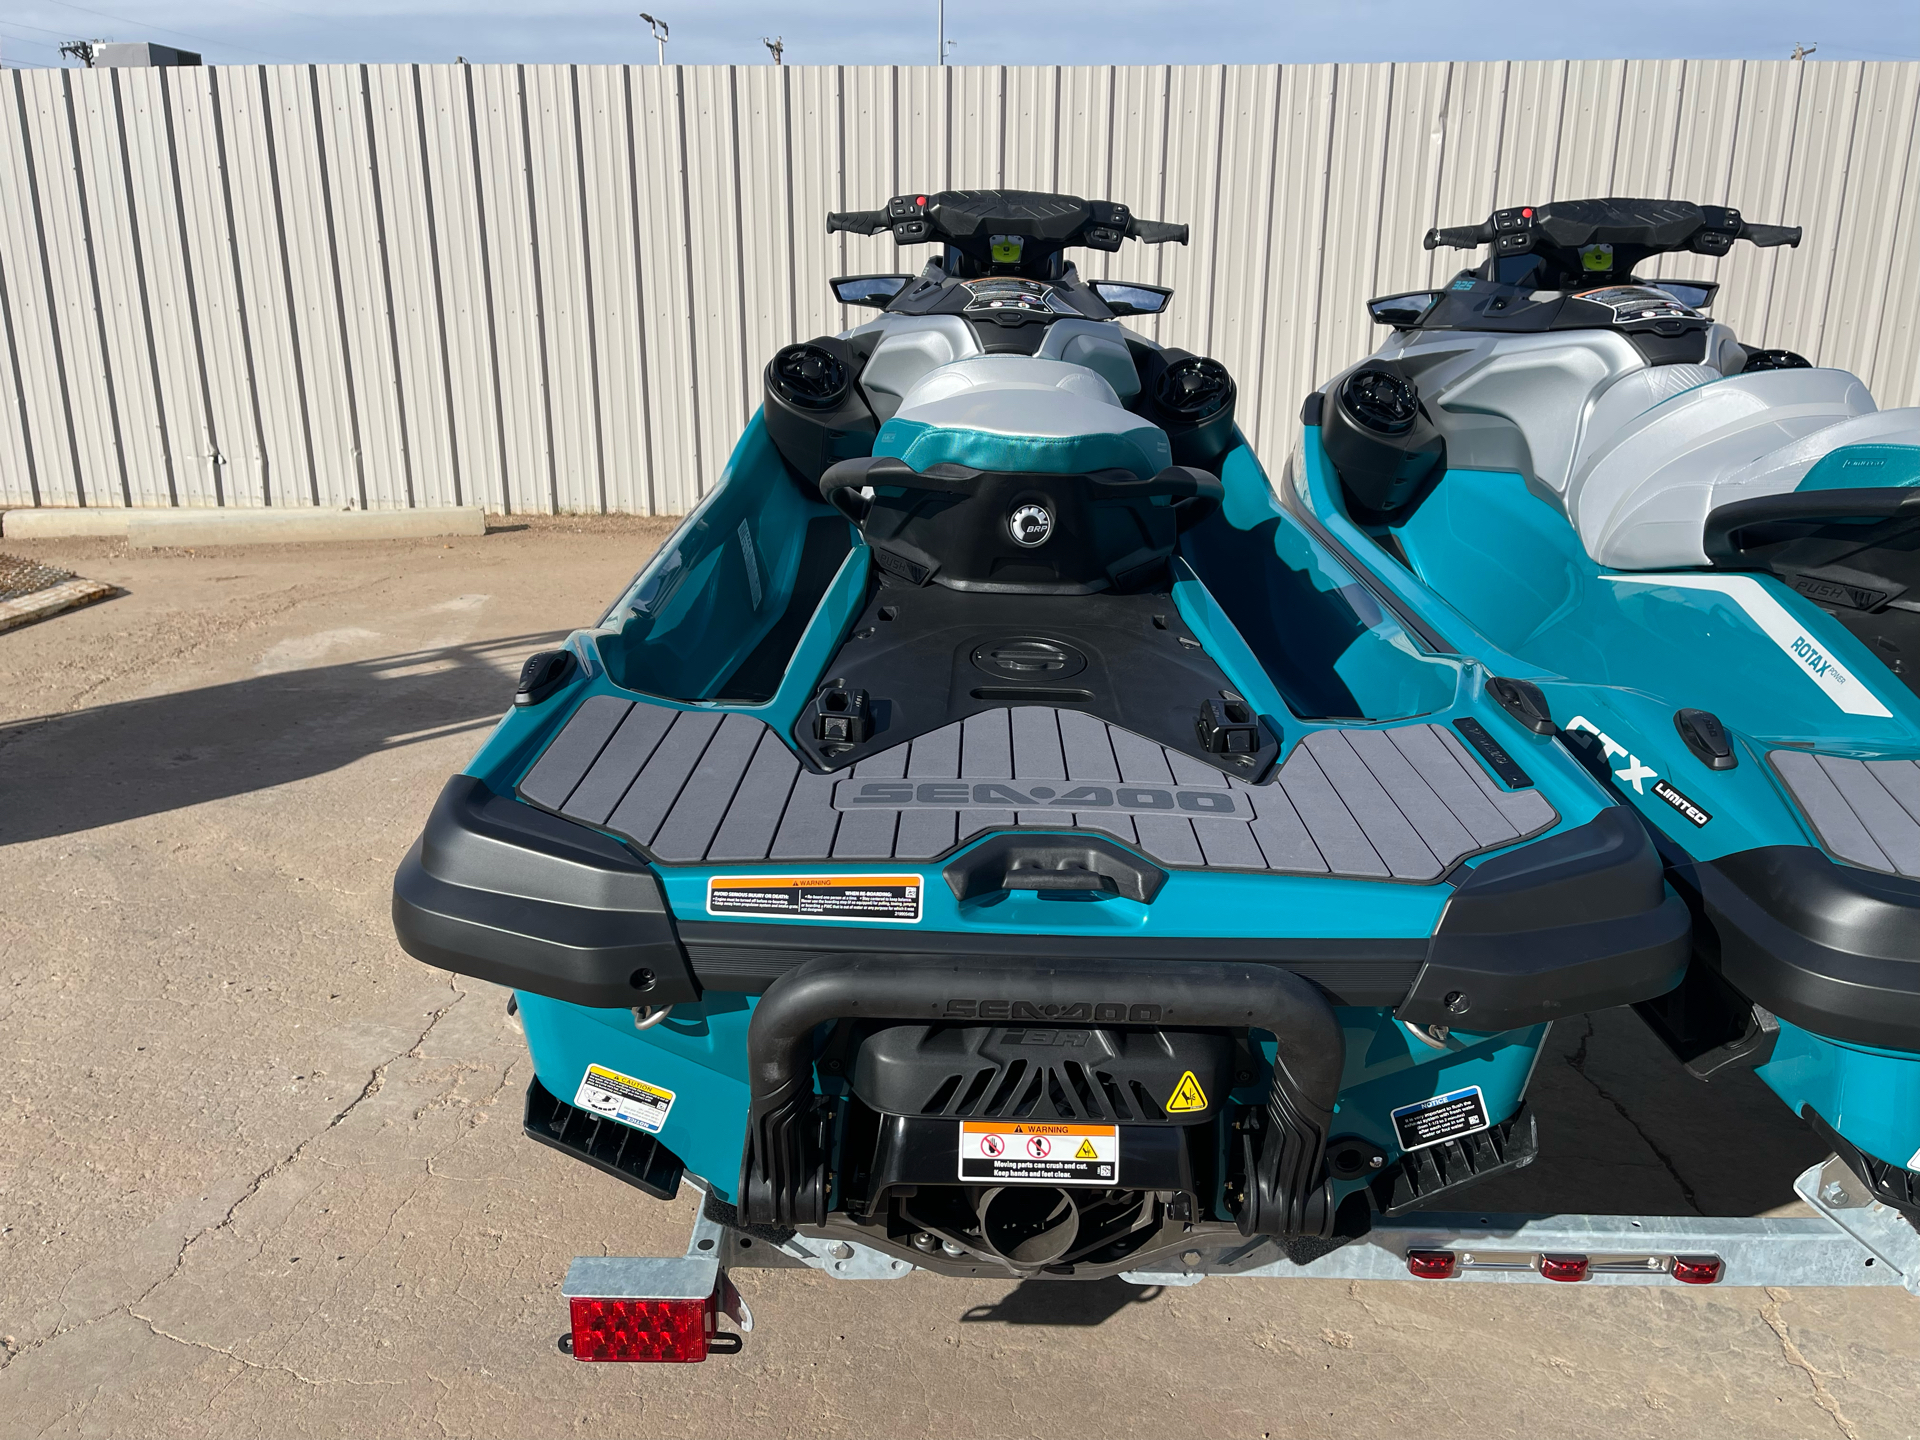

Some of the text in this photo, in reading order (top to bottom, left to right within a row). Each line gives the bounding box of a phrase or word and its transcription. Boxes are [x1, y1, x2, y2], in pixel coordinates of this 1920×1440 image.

[1026, 525, 1048, 533] BRP
[879, 553, 906, 572] PUSH
[1795, 581, 1844, 599] PUSH
[1790, 636, 1846, 685] ROTAX POWER
[1565, 715, 1658, 795] GTX
[1654, 782, 1708, 825] LIMITED
[622, 1078, 652, 1092] CAUTION
[1421, 1097, 1448, 1109] NOTICE
[627, 1117, 649, 1128] NOTICE
[1028, 1126, 1068, 1134] WARNING
[994, 1160, 1016, 1169] Moving
[994, 1170, 1009, 1178] Keep
